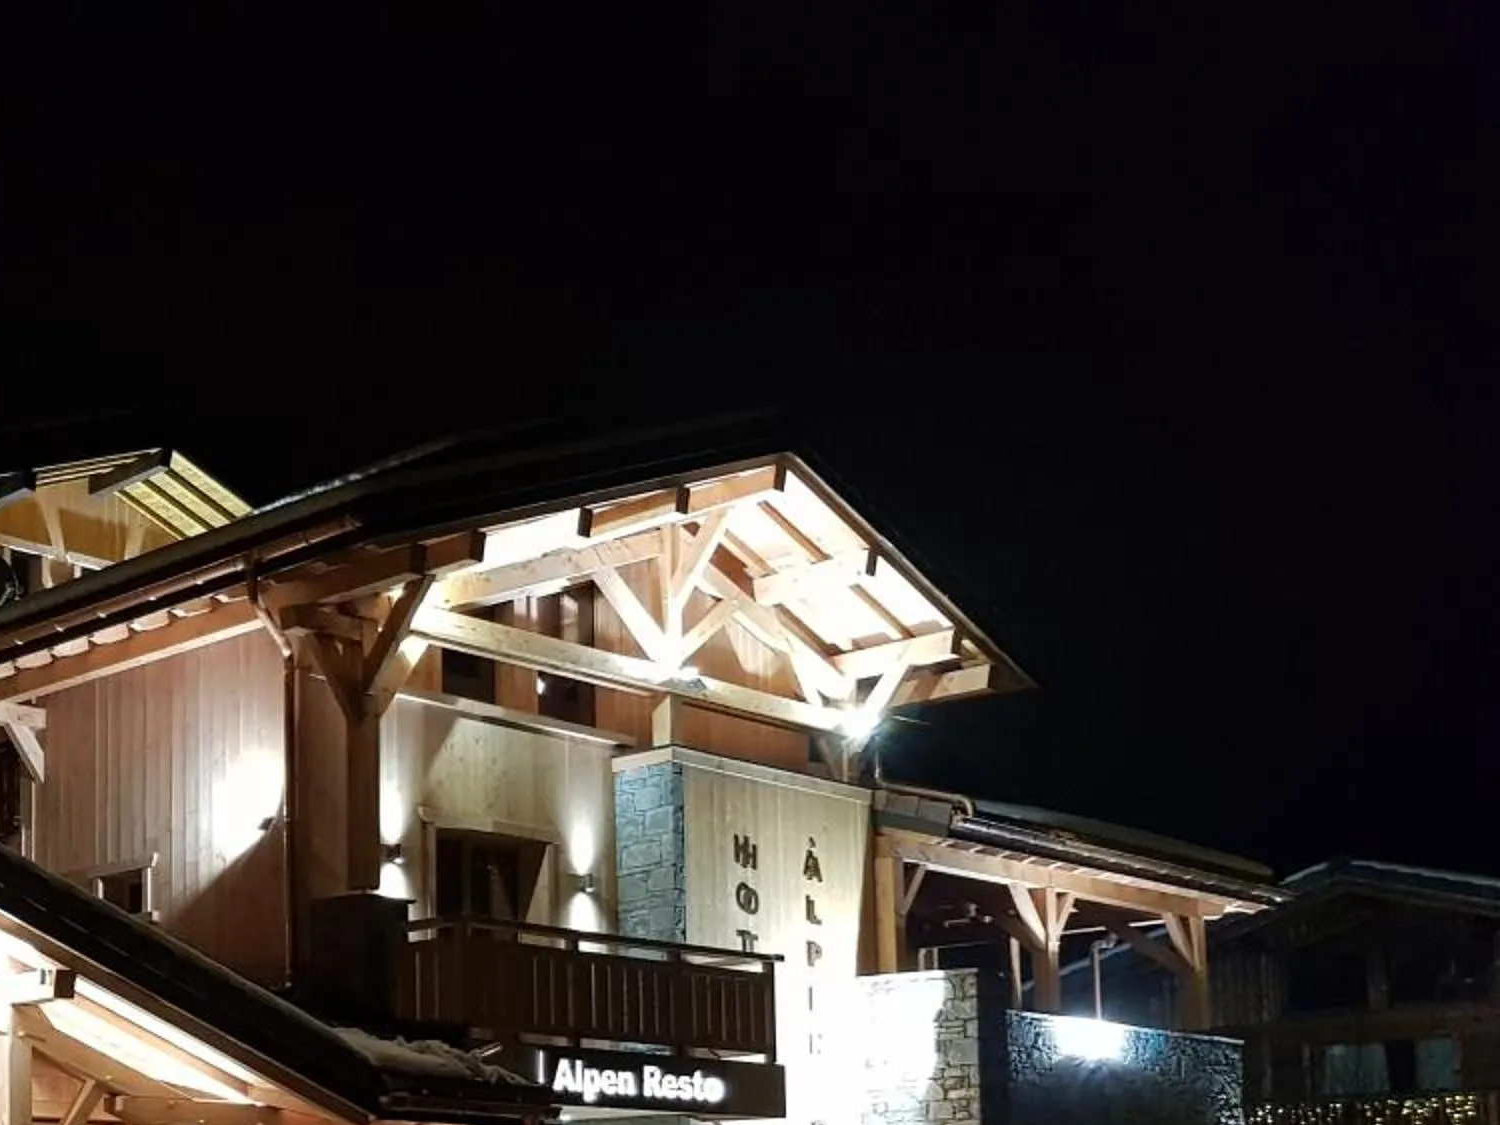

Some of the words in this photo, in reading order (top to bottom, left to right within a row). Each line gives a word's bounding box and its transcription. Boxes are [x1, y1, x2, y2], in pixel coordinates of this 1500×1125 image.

[734, 834, 759, 953] HOT
[552, 1057, 637, 1102] Alpen
[642, 1064, 726, 1102] Resto
